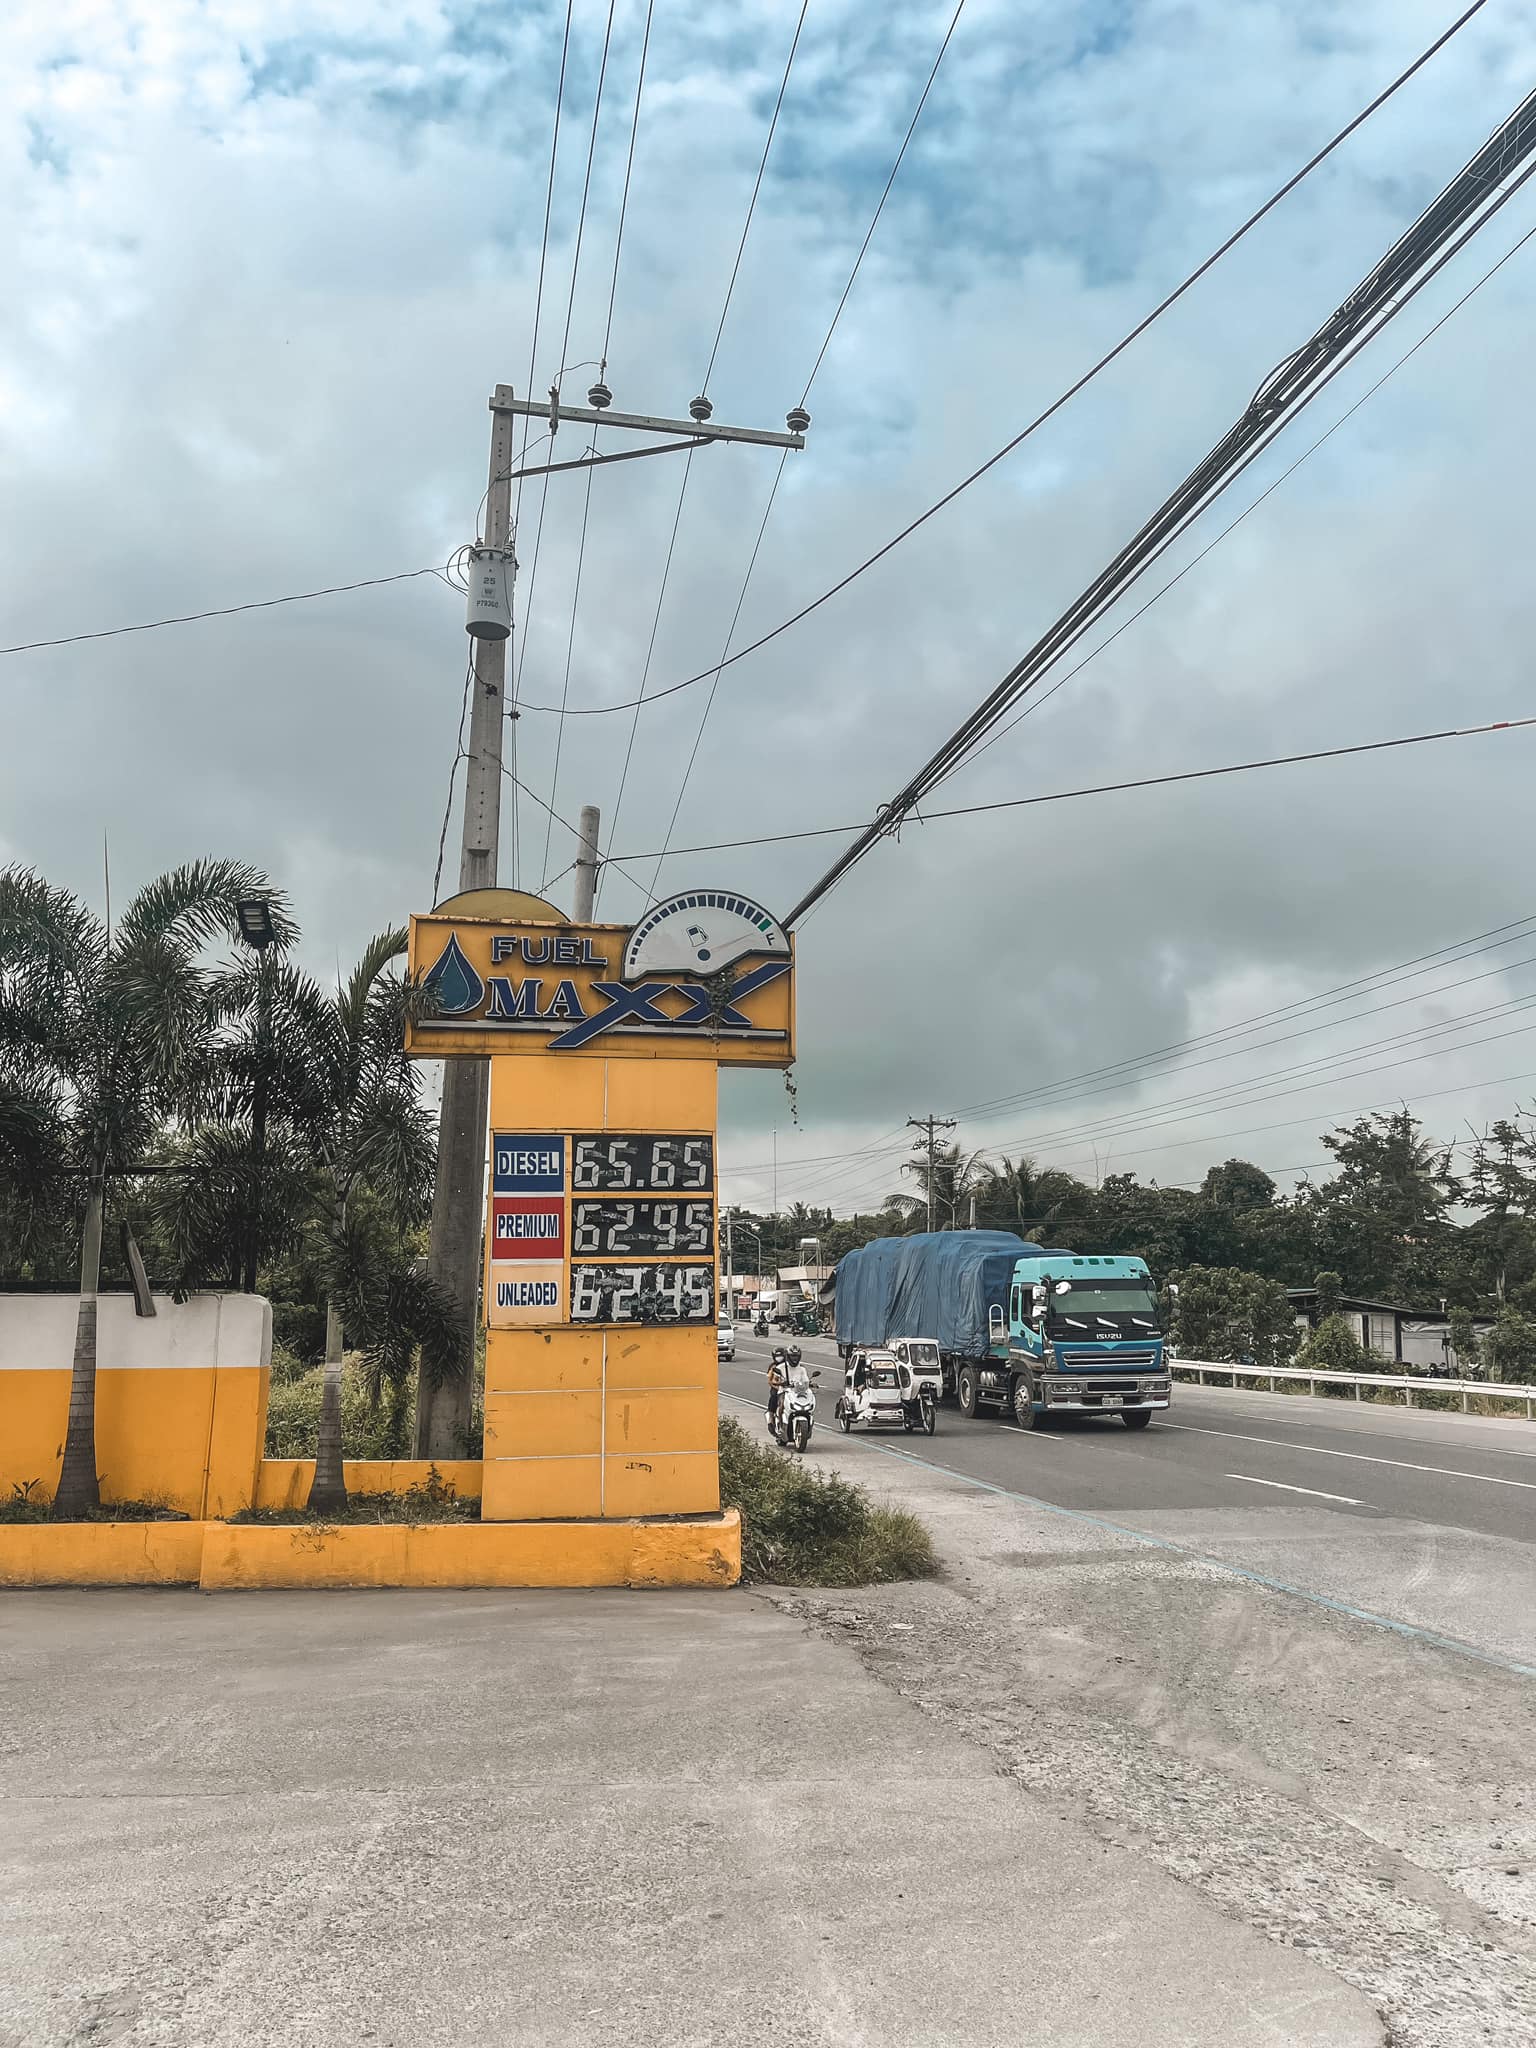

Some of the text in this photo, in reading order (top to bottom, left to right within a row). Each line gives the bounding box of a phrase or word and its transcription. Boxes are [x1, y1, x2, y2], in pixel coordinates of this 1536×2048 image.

[491, 935, 608, 967] FUEL
[765, 931, 775, 946] F
[485, 962, 794, 1049] MAXX
[498, 1141, 707, 1188] DIESEL 65.65
[498, 1214, 558, 1238] PREMIUM
[497, 1281, 558, 1307] UNLEADED
